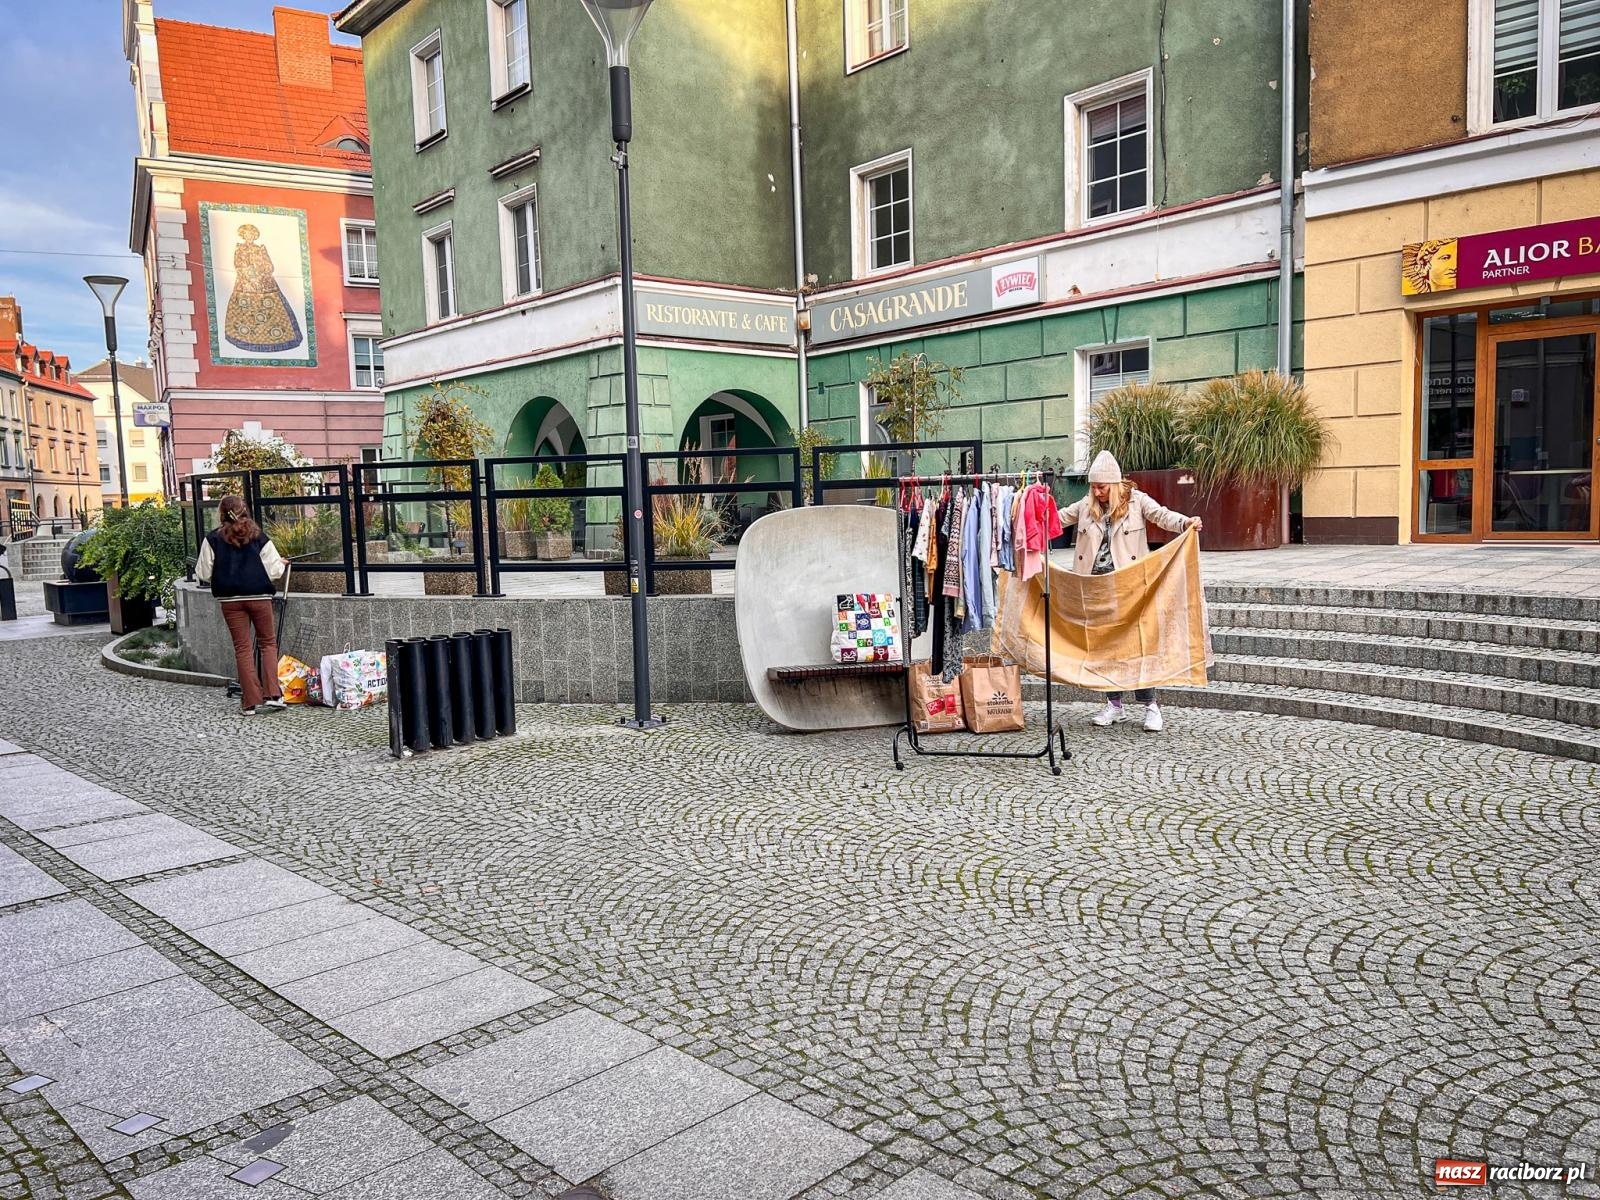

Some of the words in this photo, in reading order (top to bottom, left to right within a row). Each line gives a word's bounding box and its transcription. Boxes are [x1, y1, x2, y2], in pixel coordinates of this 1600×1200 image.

[1483, 240, 1571, 268] ALIOR
[1482, 265, 1530, 279] PARTNER
[646, 303, 738, 329] RISTORANTE
[741, 313, 752, 330] &
[754, 314, 788, 333] CAFE
[830, 280, 968, 333] CASAGRANDE
[367, 677, 388, 689] ACTIO
